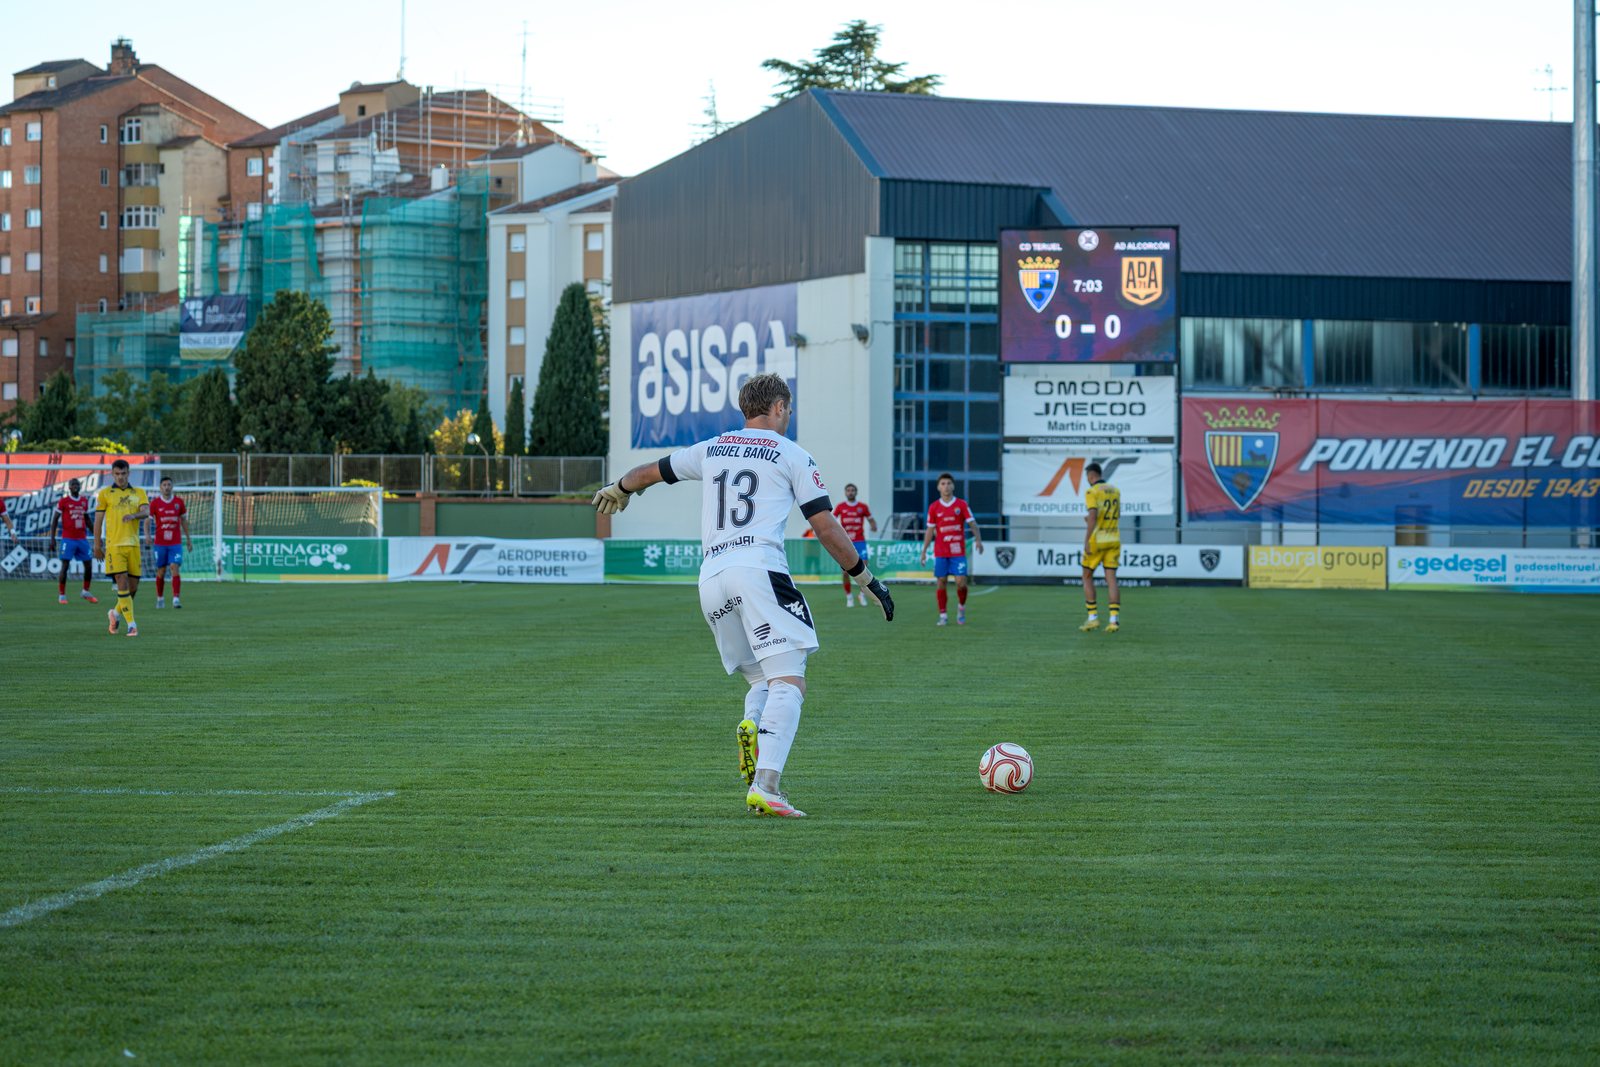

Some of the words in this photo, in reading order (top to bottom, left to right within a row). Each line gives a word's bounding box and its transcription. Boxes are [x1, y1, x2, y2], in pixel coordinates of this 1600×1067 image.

[1114, 241, 1126, 250] AD
[1073, 279, 1103, 292] 7:03
[1055, 315, 1072, 339] 0
[1104, 315, 1121, 339] 0
[1035, 381, 1144, 395] OMODA
[1034, 402, 1146, 416] JAECOO
[1090, 420, 1131, 433] Lizaga
[717, 436, 778, 449] BAUHAUS
[706, 445, 741, 459] MIGUEL
[743, 445, 781, 464] BAÑUZ
[1299, 438, 1507, 471] PONIENDO
[1511, 436, 1554, 467] EL
[1463, 479, 1541, 498] DESDE
[1543, 479, 1600, 498] 1943
[713, 469, 759, 530] 13
[1103, 499, 1119, 520] 22
[1120, 502, 1152, 513] ERUEL
[233, 543, 348, 555] FERTINAGRO
[498, 549, 587, 561] AEROPUERTO
[233, 554, 308, 566] BIOTECH
[1038, 549, 1084, 566] Mart
[1118, 549, 1177, 572] izaga
[1414, 554, 1506, 575] gedesel
[497, 565, 515, 576] DE
[519, 565, 568, 577] TERUEL
[1515, 562, 1600, 572] gedeselteruel.
[1473, 574, 1506, 582] Teruel
